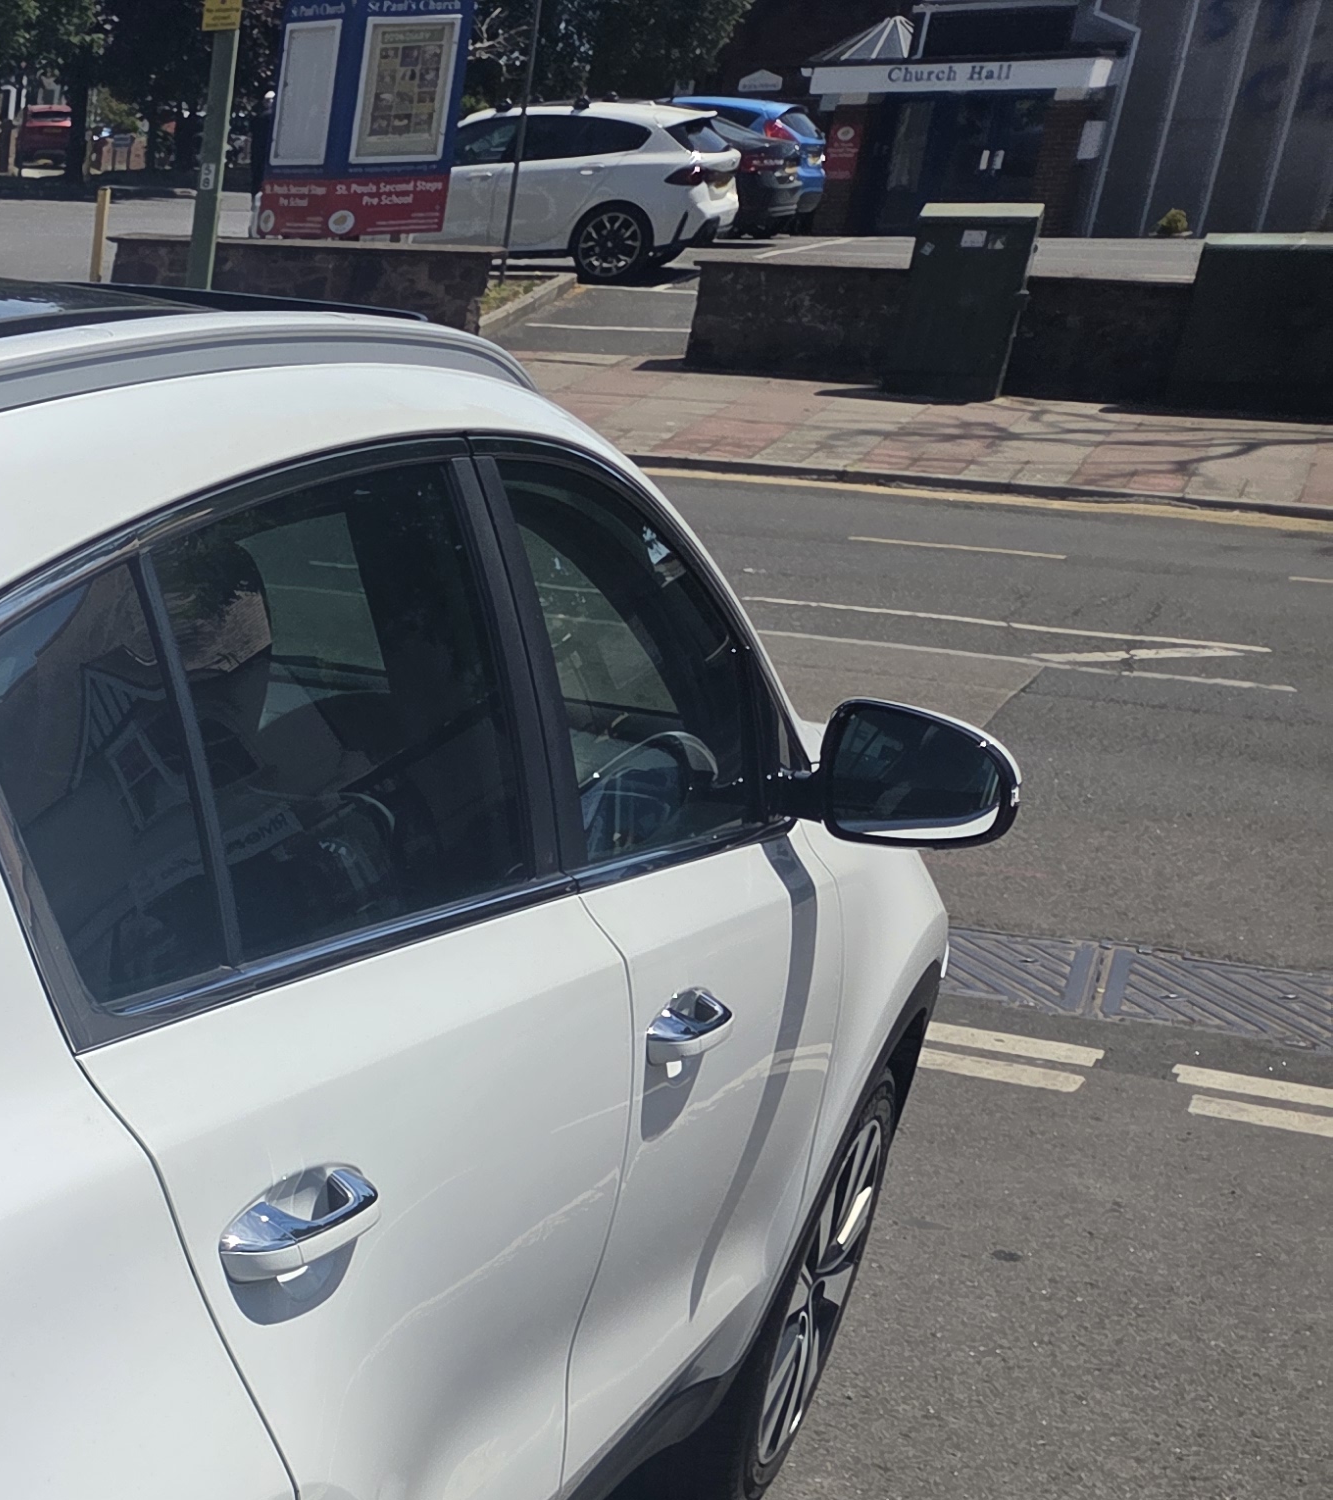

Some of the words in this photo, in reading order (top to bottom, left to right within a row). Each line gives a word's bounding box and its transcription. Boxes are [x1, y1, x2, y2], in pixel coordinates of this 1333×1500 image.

[888, 65, 957, 82] Church
[967, 63, 1012, 80] Hall
[380, 194, 414, 206] School
